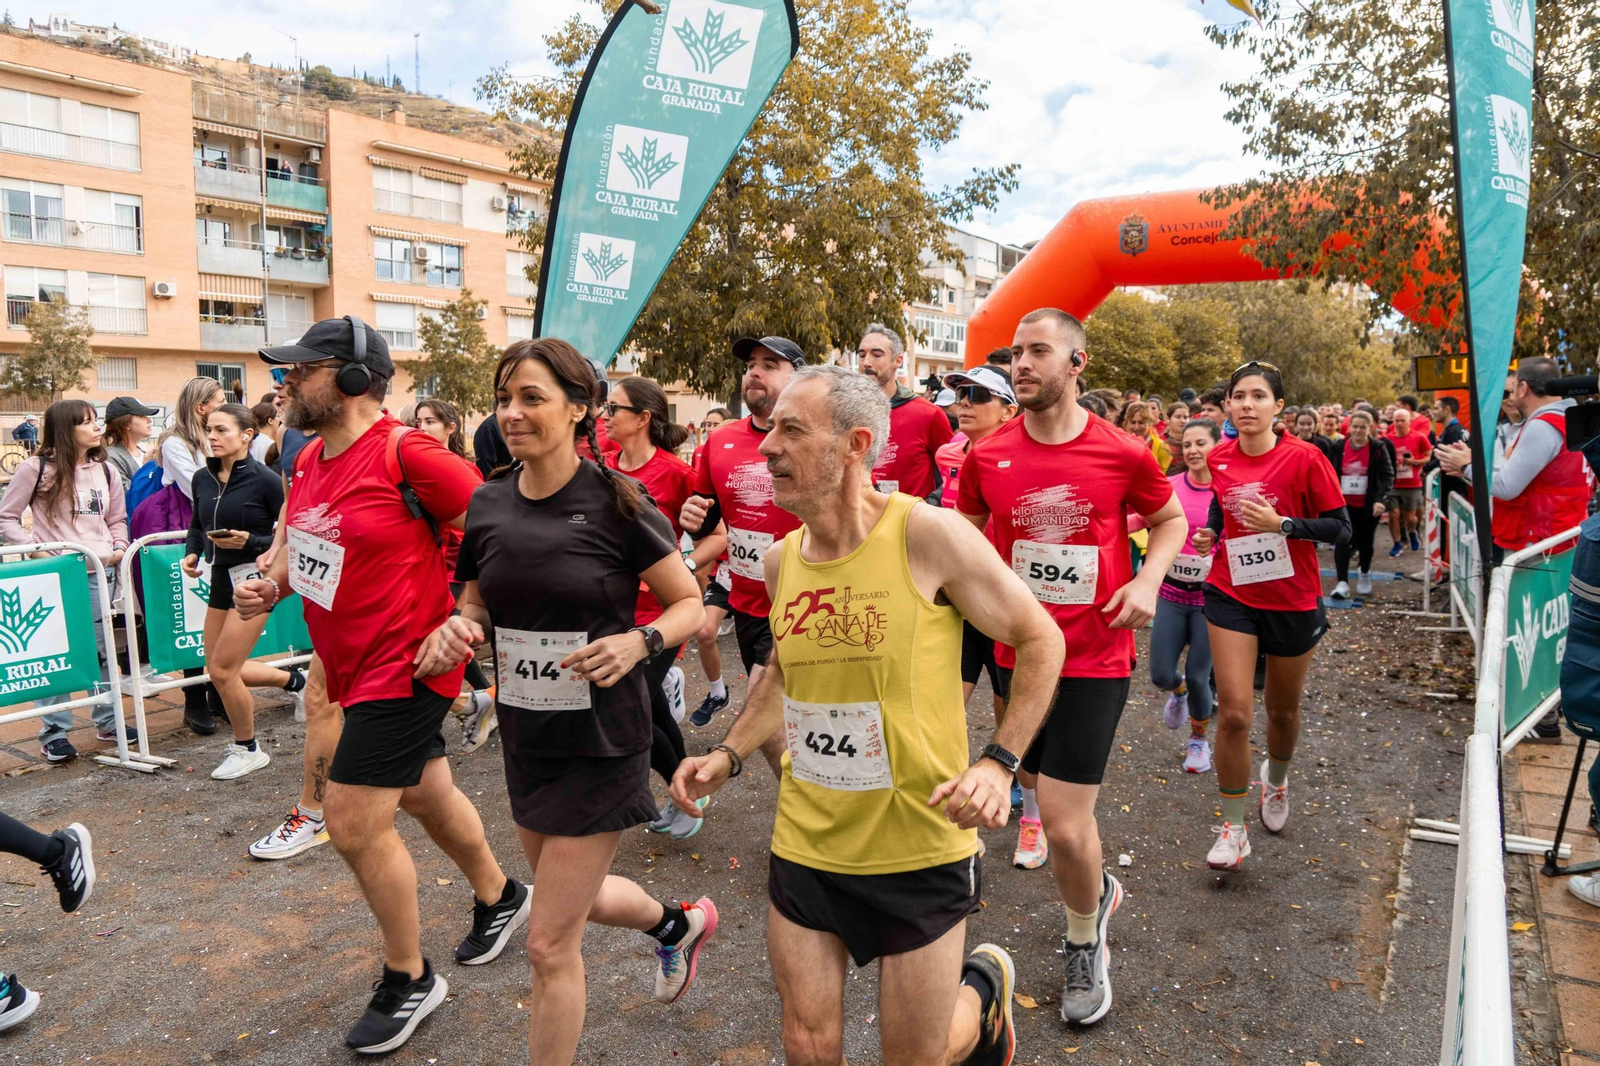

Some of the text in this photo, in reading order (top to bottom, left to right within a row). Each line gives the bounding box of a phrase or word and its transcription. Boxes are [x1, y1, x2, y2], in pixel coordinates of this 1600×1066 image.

[642, 75, 745, 107] CAJA RURAL
[662, 94, 722, 114] GRANADA
[595, 124, 613, 188] fundación
[1491, 175, 1515, 192] CAJA
[595, 191, 678, 215] CAJA RURAL
[611, 206, 660, 222] GRANADA
[567, 233, 579, 281] fundación
[566, 283, 629, 301] CAJA RURAL
[576, 294, 614, 305] GRANADA
[1012, 515, 1090, 527] HUMANIDAD
[732, 543, 759, 562] 204
[1238, 550, 1276, 566] 1330
[298, 552, 330, 580] 577
[1029, 562, 1080, 584] 594
[1173, 564, 1201, 576] 1187
[169, 562, 183, 634] fundación
[774, 587, 836, 641] 525
[175, 633, 205, 649] CAJ
[5, 656, 72, 680] RURAL
[515, 659, 560, 681] 414
[0, 676, 51, 695] ANADA
[805, 731, 858, 758] 424
